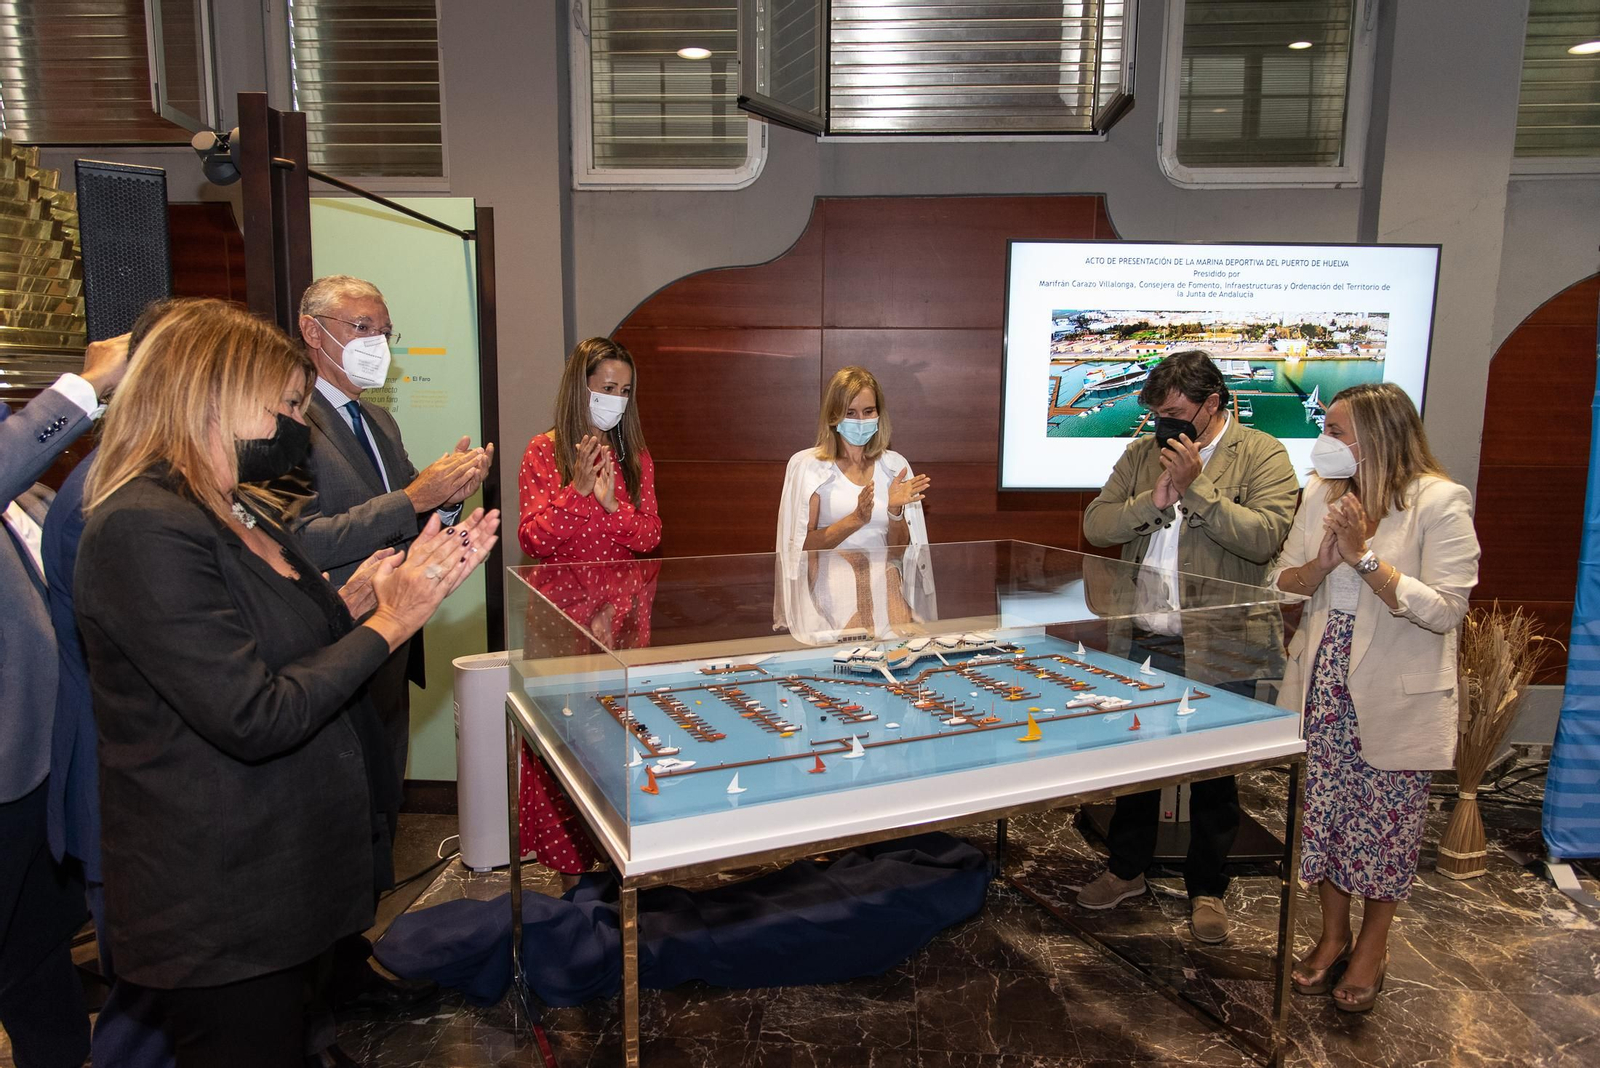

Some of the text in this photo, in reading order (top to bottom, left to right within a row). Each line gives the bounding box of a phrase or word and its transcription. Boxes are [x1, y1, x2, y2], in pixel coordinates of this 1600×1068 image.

[1085, 257, 1105, 265] ACTO
[1107, 257, 1117, 265] DE
[1118, 257, 1172, 266] PRESENTACIÓN
[1174, 258, 1183, 266] DE
[1185, 258, 1195, 266] LA
[1195, 258, 1224, 266] MARINA
[1266, 259, 1279, 267] DEL
[1281, 259, 1309, 267] PUERTO
[1193, 270, 1226, 278] Presidido
[1038, 279, 1069, 288] Marifrán
[1071, 280, 1097, 288] Carazo
[1098, 280, 1137, 289] Villalonga,
[1139, 281, 1175, 290] Consejera
[1177, 281, 1186, 289] de
[1188, 281, 1222, 290] Fomento,
[1224, 282, 1282, 290] Infraestructuras
[1346, 283, 1380, 291] Territorio
